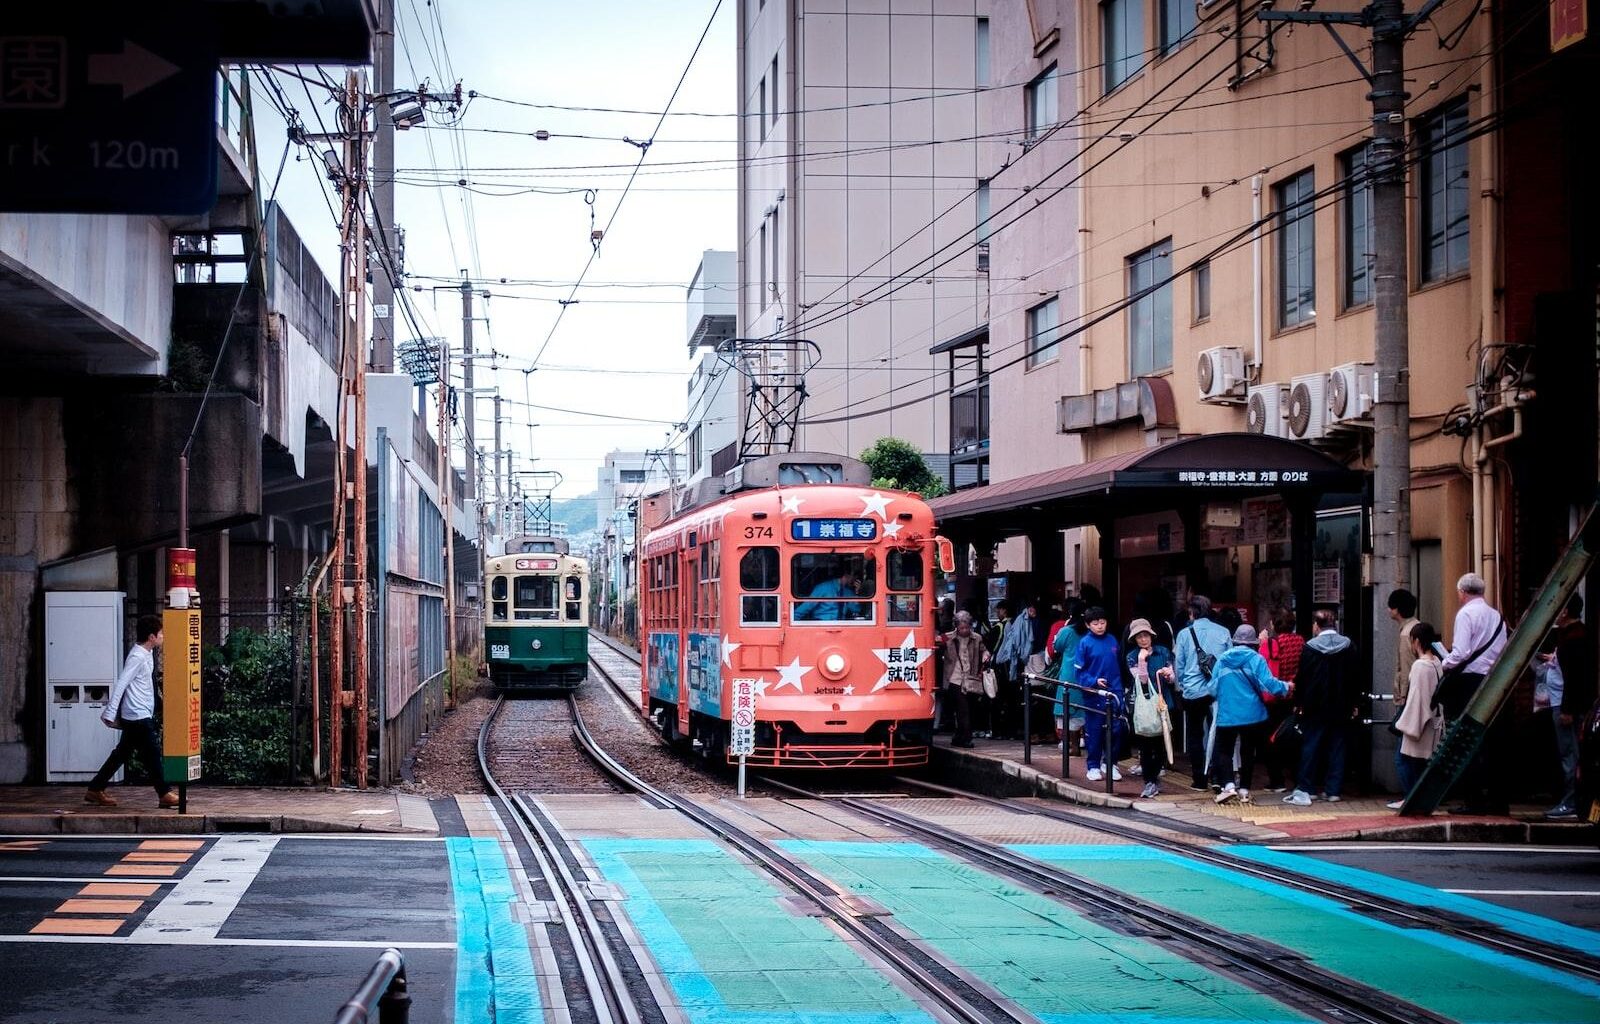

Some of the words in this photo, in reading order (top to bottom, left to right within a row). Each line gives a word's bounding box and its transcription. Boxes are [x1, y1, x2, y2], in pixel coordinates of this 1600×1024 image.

[0, 35, 67, 110] 園
[88, 138, 181, 170] 120m
[1282, 471, 1309, 482] のりば
[744, 526, 773, 539] 374
[796, 520, 811, 538] 1
[819, 523, 873, 538] 崇福寺
[887, 647, 919, 663] 長崎
[188, 614, 200, 751] 電車に注意
[813, 686, 844, 696] Jetstar
[738, 682, 752, 709] 危険
